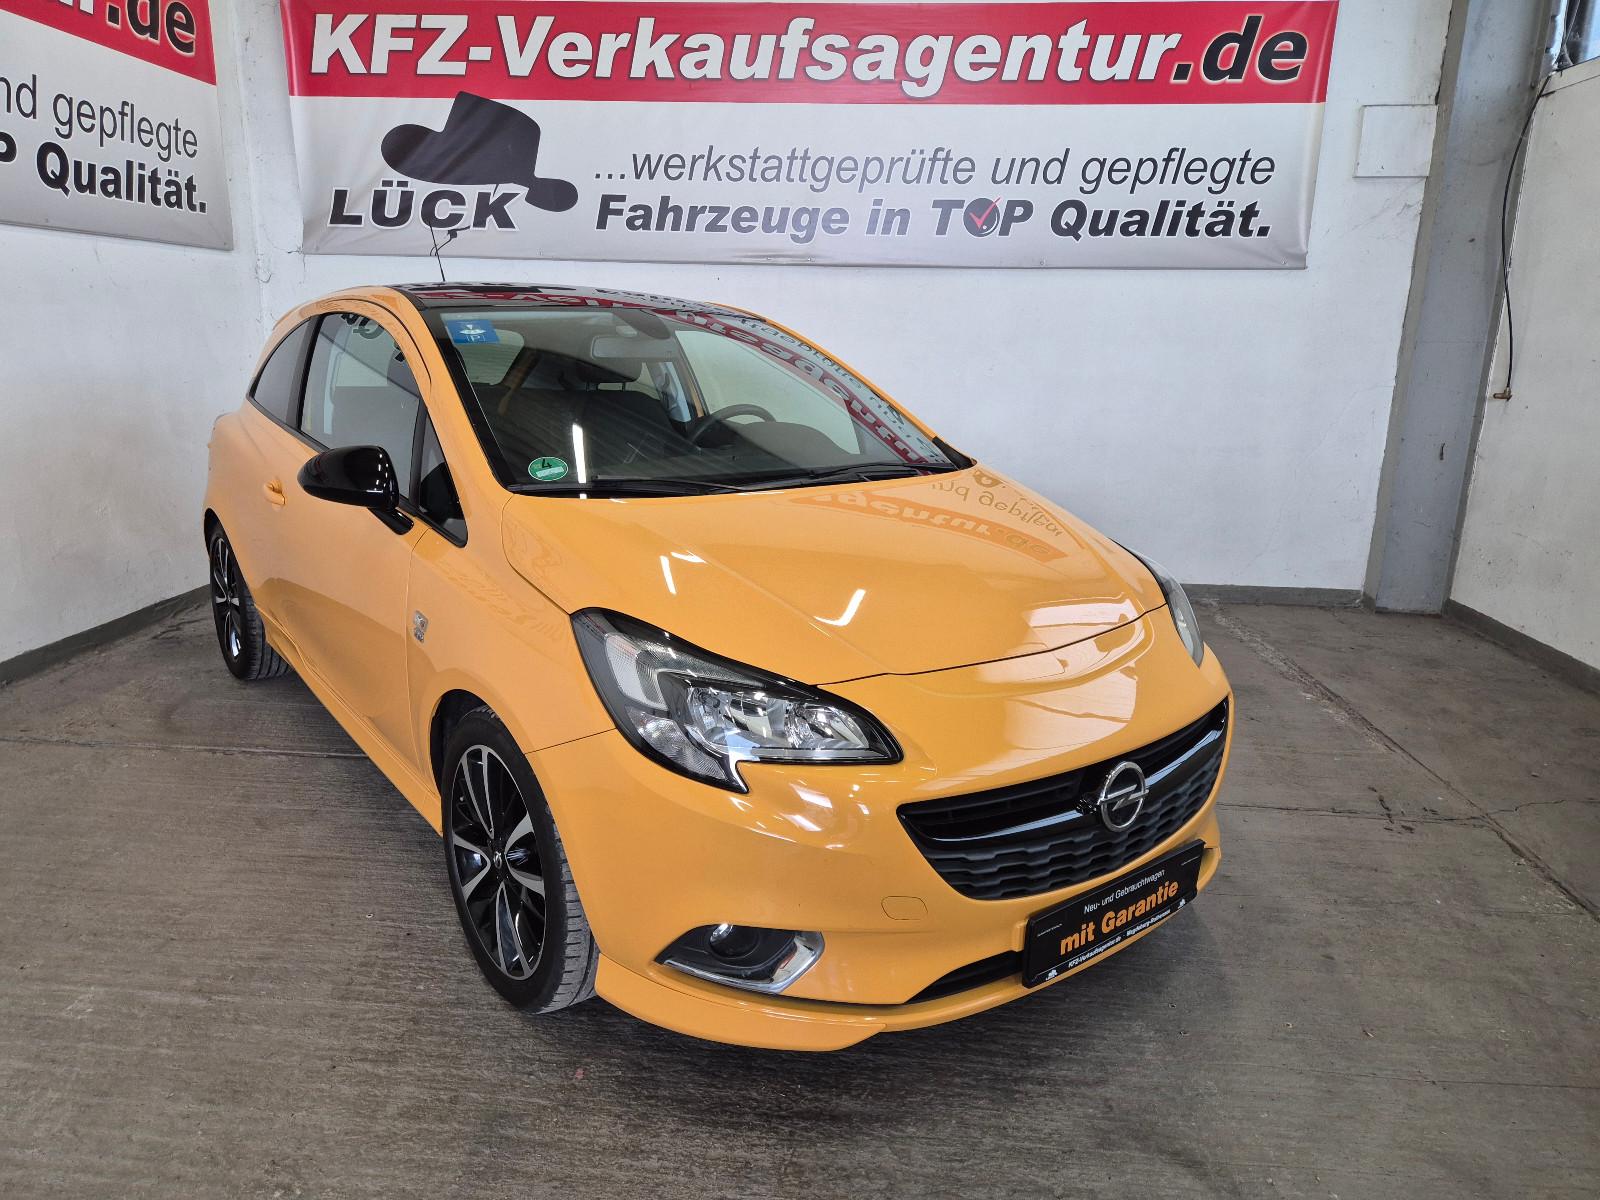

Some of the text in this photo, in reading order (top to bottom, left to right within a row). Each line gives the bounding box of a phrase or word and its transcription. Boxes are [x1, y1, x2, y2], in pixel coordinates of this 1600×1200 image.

[311, 13, 1308, 98] KFZ-Verkaufsagentur.de
[53, 93, 198, 162] gepflegte
[37, 141, 207, 214] Qualität.
[990, 148, 1070, 185] und
[1080, 147, 1275, 195] gepflegte
[327, 180, 521, 231] LÜCK
[595, 193, 849, 244] Fahrzeuge
[865, 198, 910, 237] in
[1050, 198, 1271, 241] Qualität.
[1060, 879, 1179, 956] mit Garantie
[1083, 869, 1166, 915] Neu- und Gebrauchtwagen
